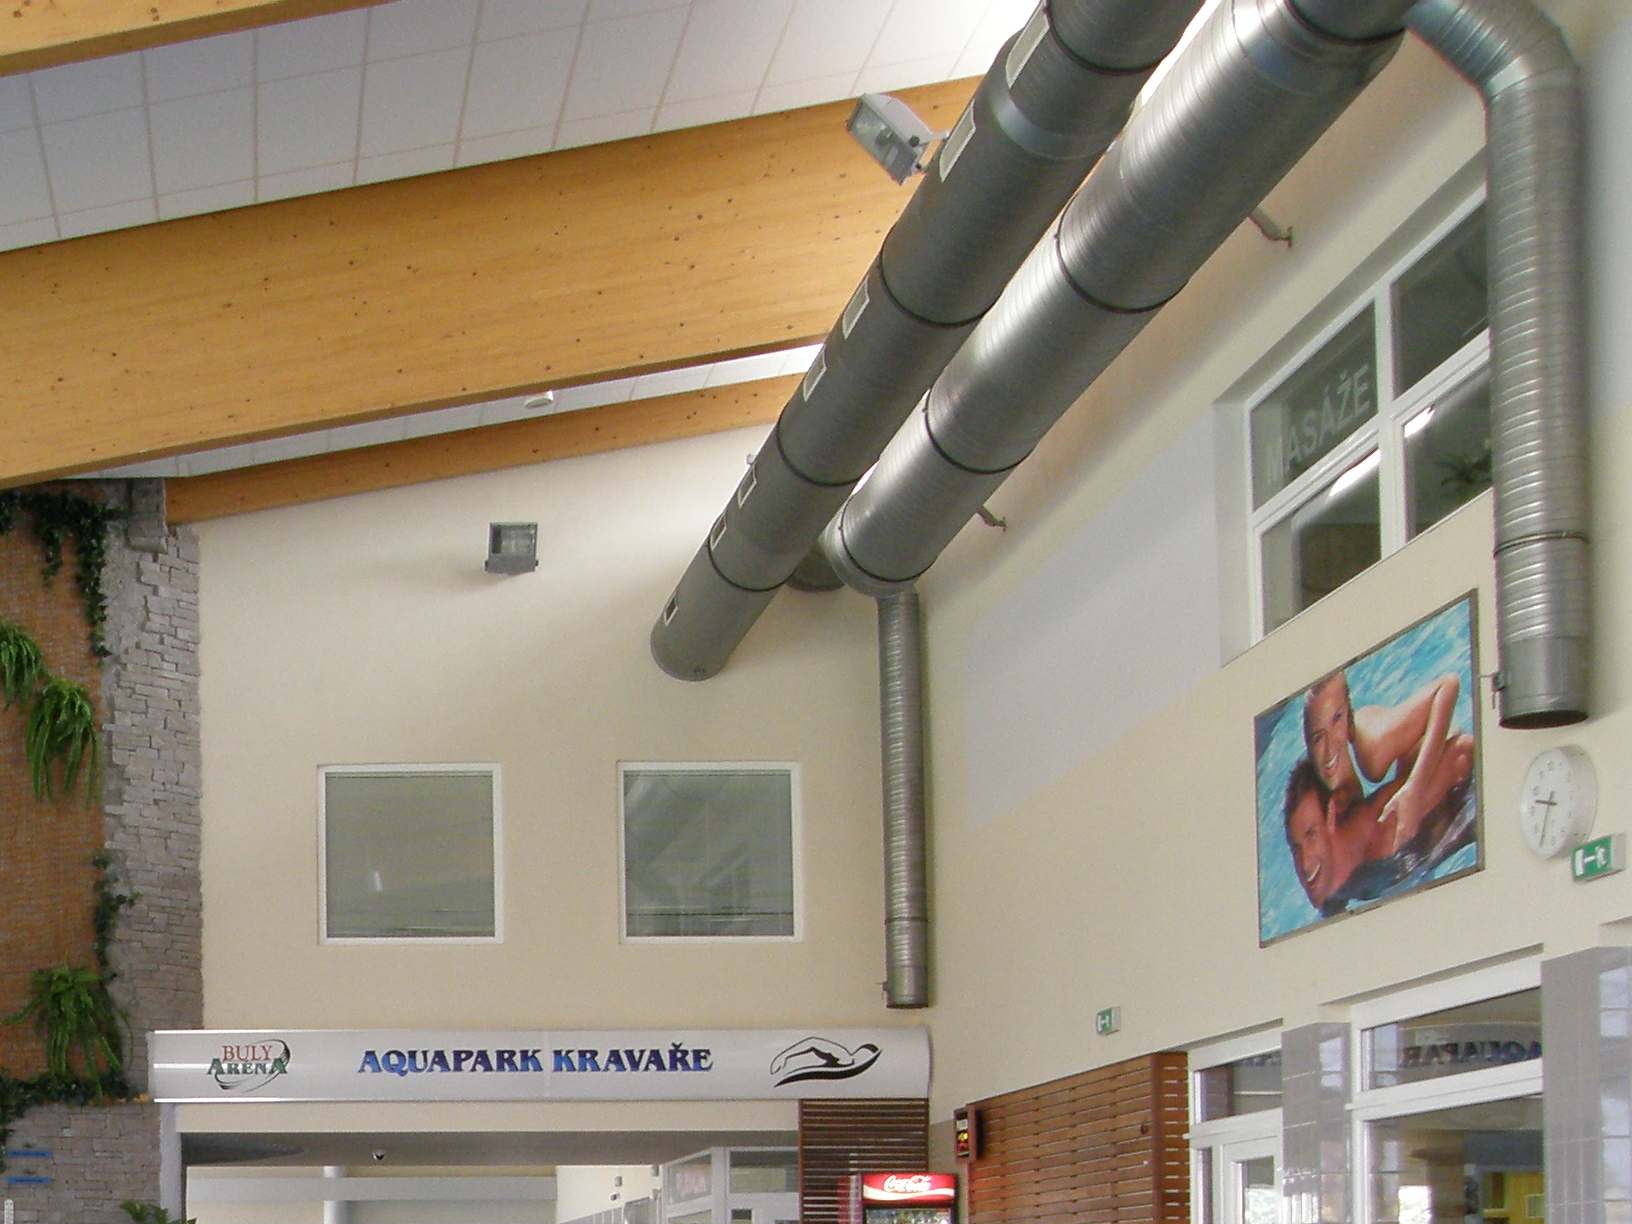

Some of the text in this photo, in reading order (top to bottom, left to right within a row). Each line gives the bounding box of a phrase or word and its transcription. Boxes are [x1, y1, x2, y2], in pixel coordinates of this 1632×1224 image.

[1267, 362, 1370, 484] MASÁŽE
[206, 1057, 288, 1075] ARENA
[221, 1045, 273, 1061] BULY
[357, 1042, 714, 1077] AQUAPARK KRAVAŘE
